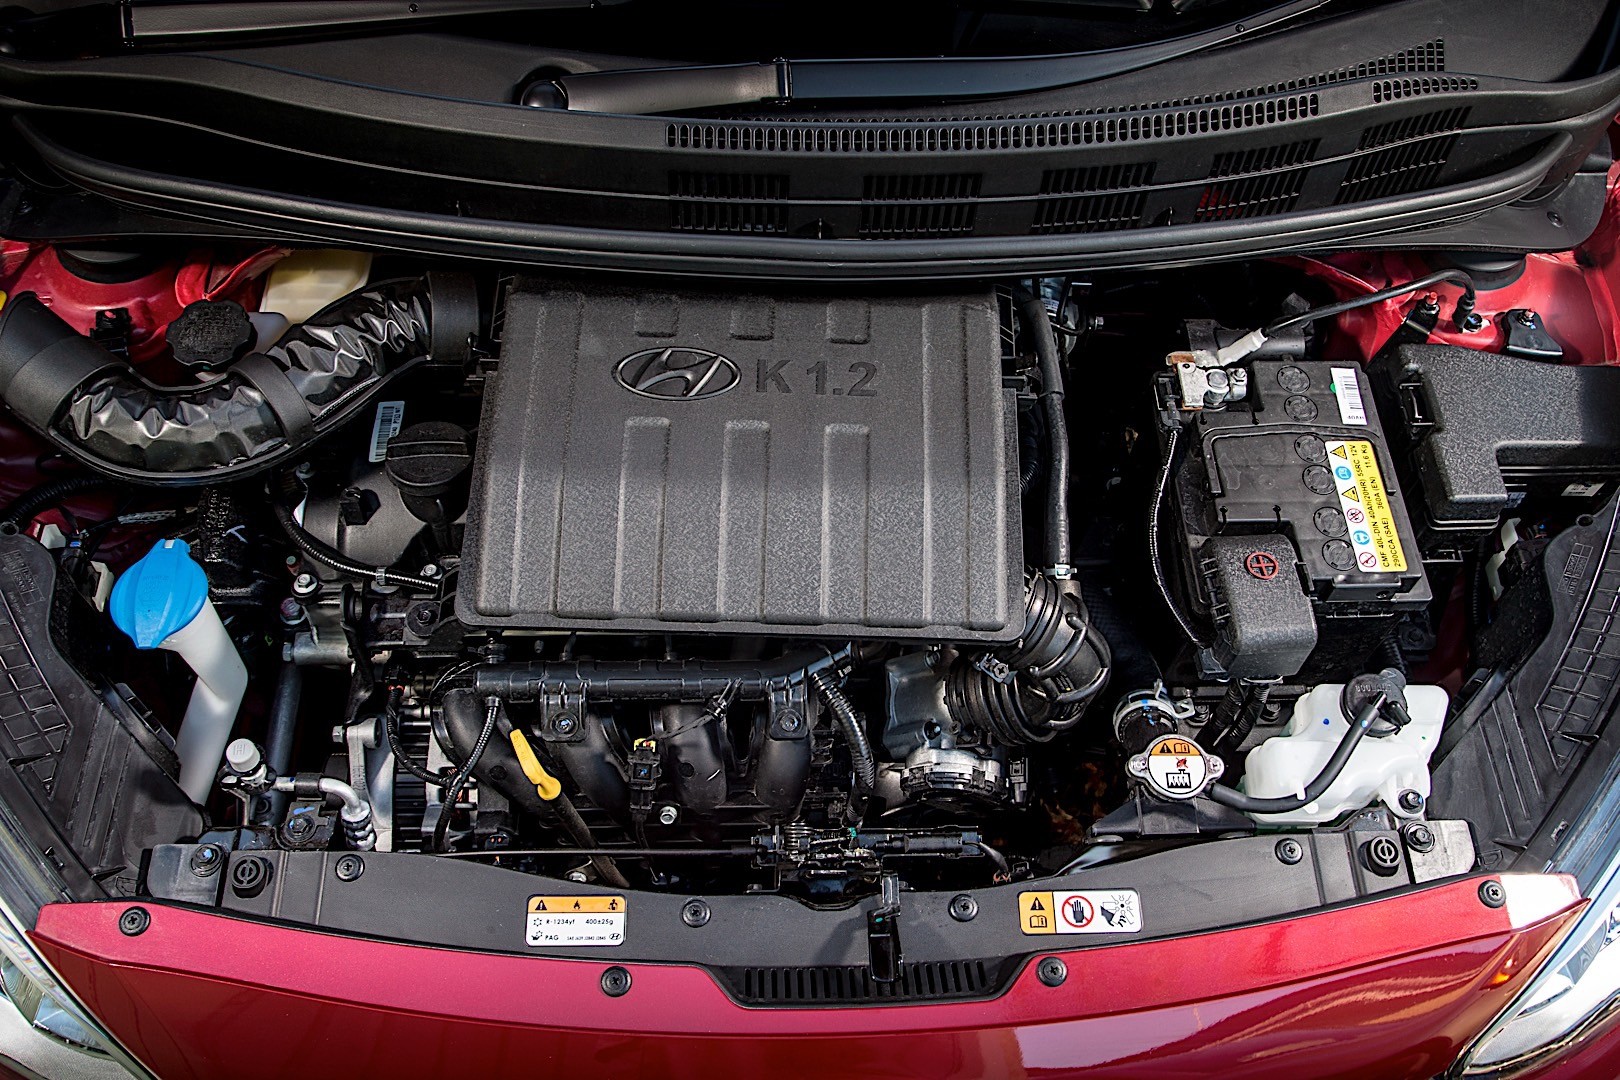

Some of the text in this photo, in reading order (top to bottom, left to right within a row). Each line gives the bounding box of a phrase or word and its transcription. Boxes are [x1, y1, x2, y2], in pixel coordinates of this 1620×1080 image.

[756, 359, 878, 396] K 1.2
[1349, 444, 1358, 456] 12V
[1361, 444, 1368, 455] Kg
[1353, 459, 1364, 477] 55RC
[1369, 476, 1380, 492] (EN)
[1375, 492, 1385, 509] 360A
[1371, 521, 1384, 549] 40L-DIN
[1381, 517, 1392, 538] (SAE)
[1379, 551, 1390, 568] CMF
[1388, 539, 1401, 567] 290CCA
